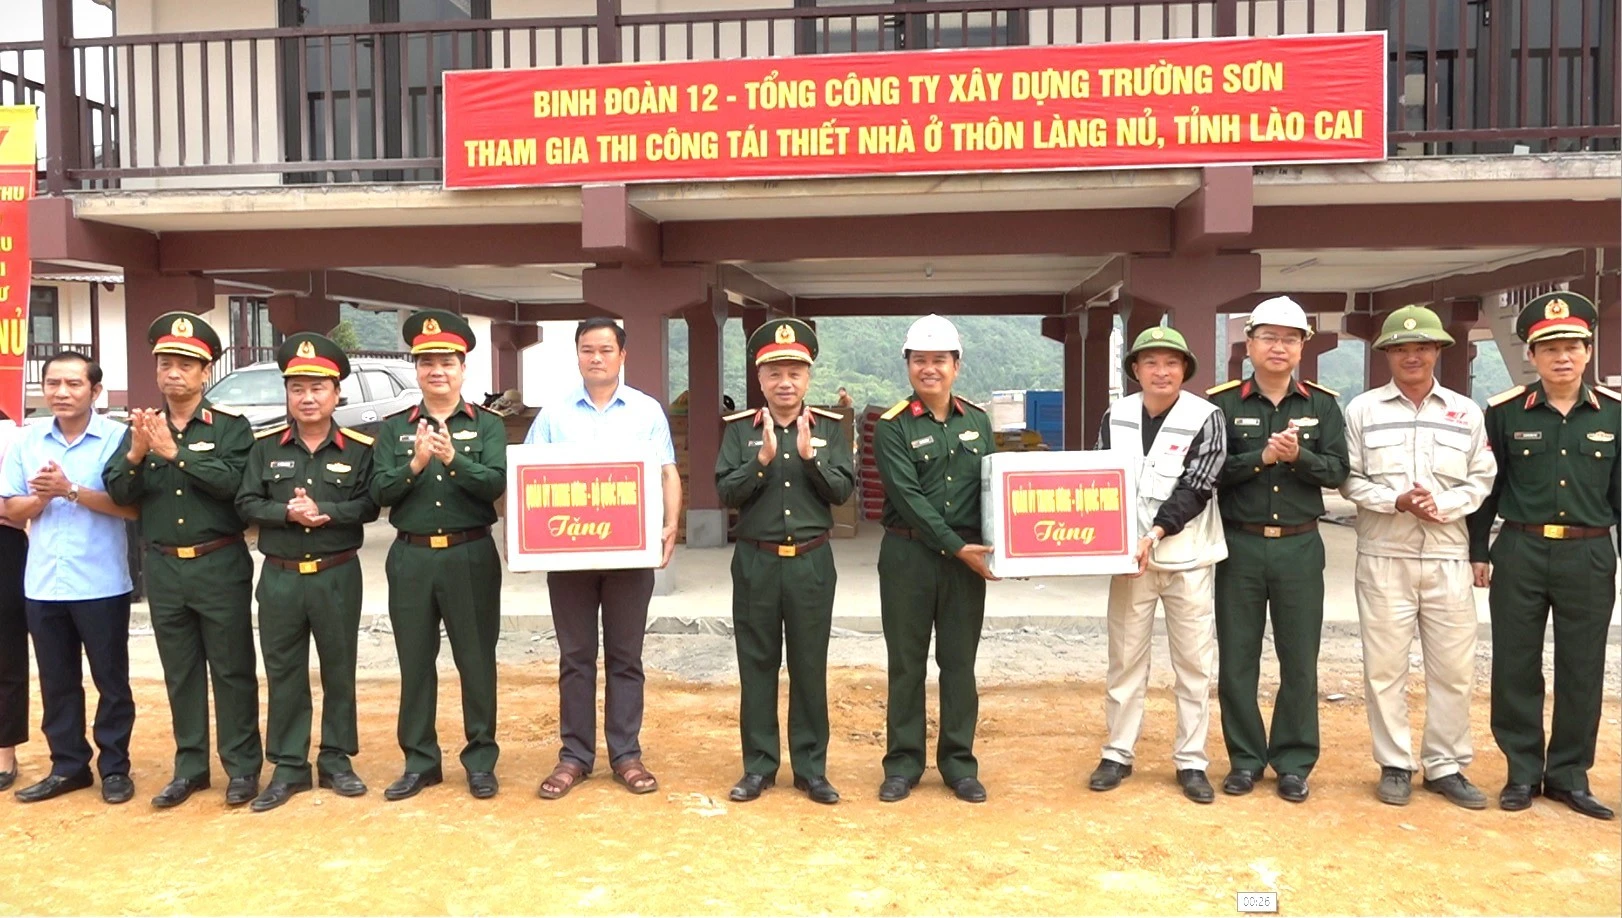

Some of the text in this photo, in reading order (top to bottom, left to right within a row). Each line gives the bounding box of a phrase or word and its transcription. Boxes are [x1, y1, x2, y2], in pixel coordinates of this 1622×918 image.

[534, 89, 597, 118] BINH
[604, 81, 678, 115] ĐOÀN
[686, 84, 719, 112] 12
[745, 70, 817, 110] TỔNG
[825, 72, 900, 108] CÔNG
[908, 75, 941, 103] TY
[949, 68, 1004, 103] XÂY
[1012, 68, 1090, 106] DỰNG
[1098, 60, 1213, 97] TRƯỜNG
[1223, 60, 1284, 94] SƠN
[464, 106, 1363, 167] THAM GIA THI CÔNG TÁI THIẾT NHÀ Ở THÔN LÀNG NỦ, TỈNH LÀO CAI
[547, 514, 612, 541] Tặng
[1033, 520, 1096, 547] Tặng
